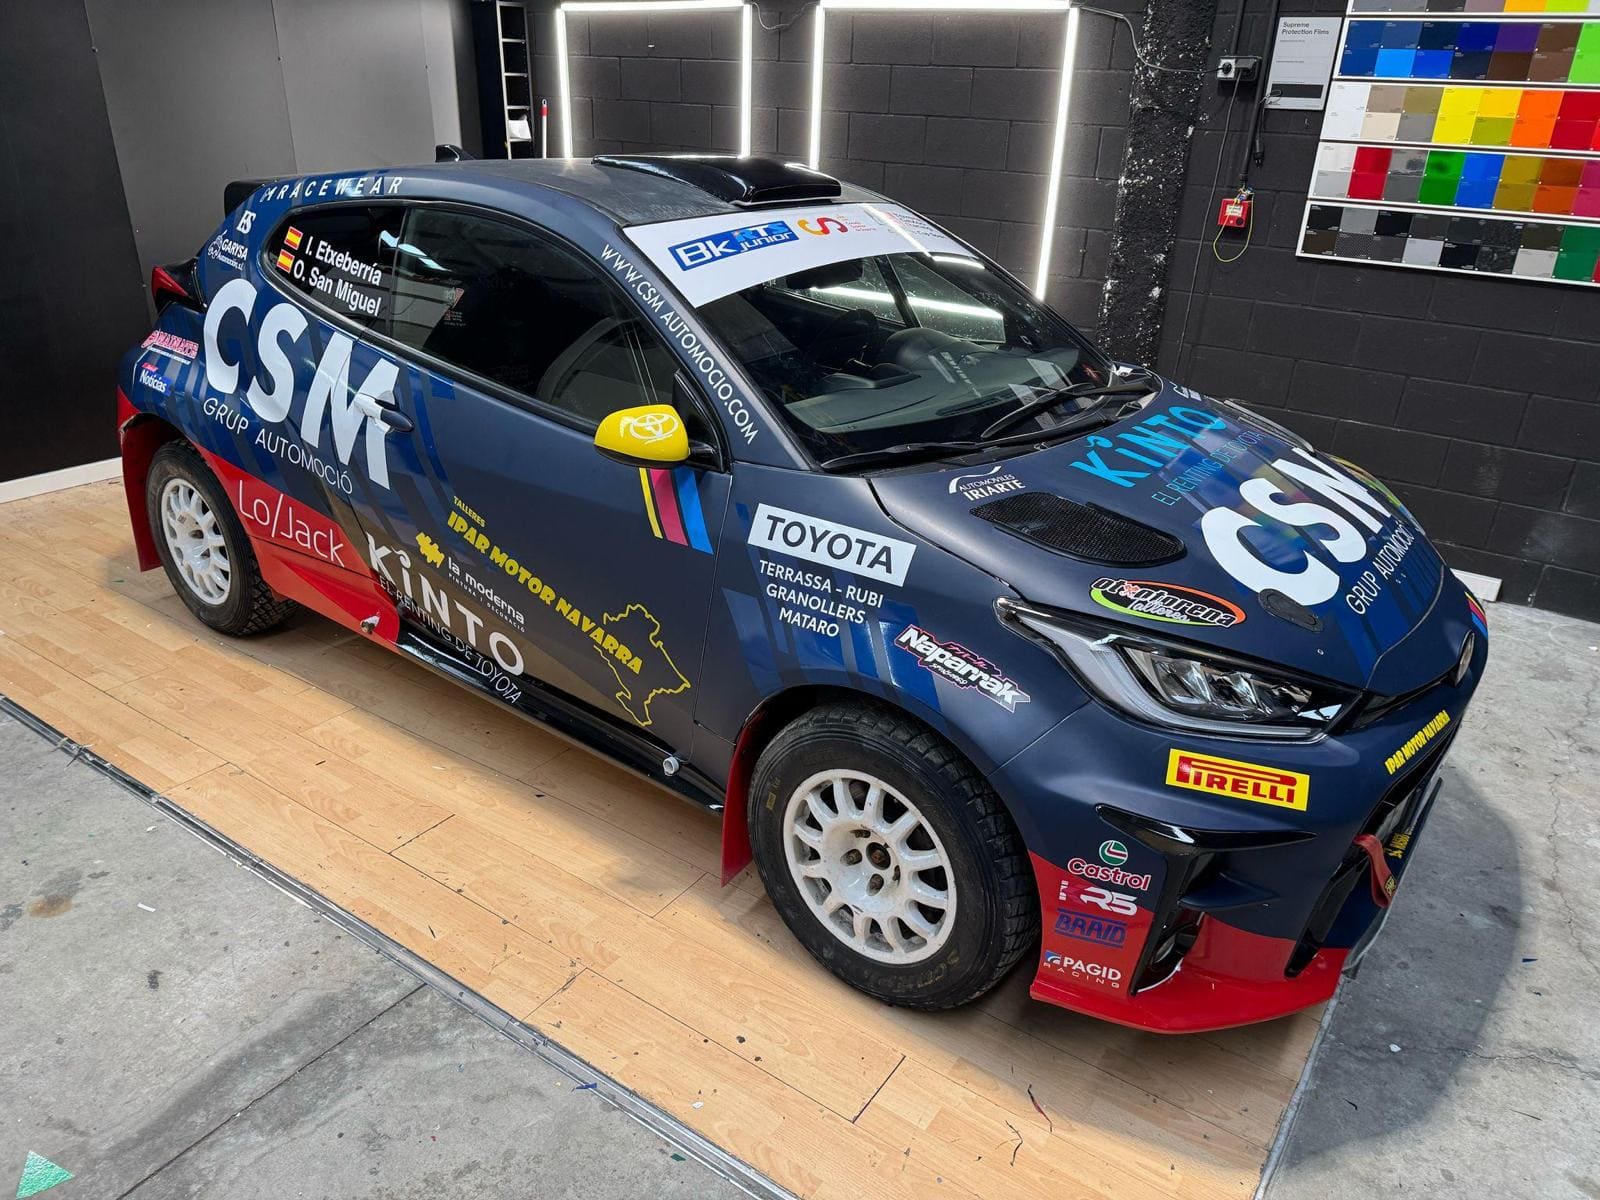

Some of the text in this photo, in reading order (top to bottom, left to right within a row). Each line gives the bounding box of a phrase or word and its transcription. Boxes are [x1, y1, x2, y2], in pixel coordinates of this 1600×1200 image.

[305, 235, 382, 286] I. Etxeberría
[293, 259, 382, 317] O. San Miguel
[139, 369, 167, 394] Noticias
[203, 278, 400, 491] CSM
[660, 311, 759, 445] AUTOMOCIO.COM
[203, 397, 353, 494] GRUP AUTOMOCIÓ
[963, 479, 1026, 501] IRIARTE
[1151, 491, 1181, 506] EL
[1166, 458, 1224, 492] RENTING
[1210, 448, 1237, 463] DE
[453, 495, 486, 528] TALLERES
[1201, 446, 1392, 606] CSM
[766, 514, 893, 575] TOYOTA
[447, 510, 643, 675] IPAR MOTOR NAVARRA
[448, 556, 525, 625] la moderna
[759, 559, 832, 594] TERRASSA
[845, 585, 884, 609] RUBI
[766, 583, 866, 625] GRANOLLERS
[1346, 570, 1382, 615] GRUP
[396, 591, 452, 641] RENTING
[455, 637, 472, 661] DE
[476, 653, 522, 704] TOYOTA
[778, 607, 840, 638] MATARO
[1176, 755, 1298, 804] PIRELLI
[1067, 857, 1152, 891] Castrol
[1043, 962, 1121, 989] RACING
[1062, 956, 1122, 981] PAGID
